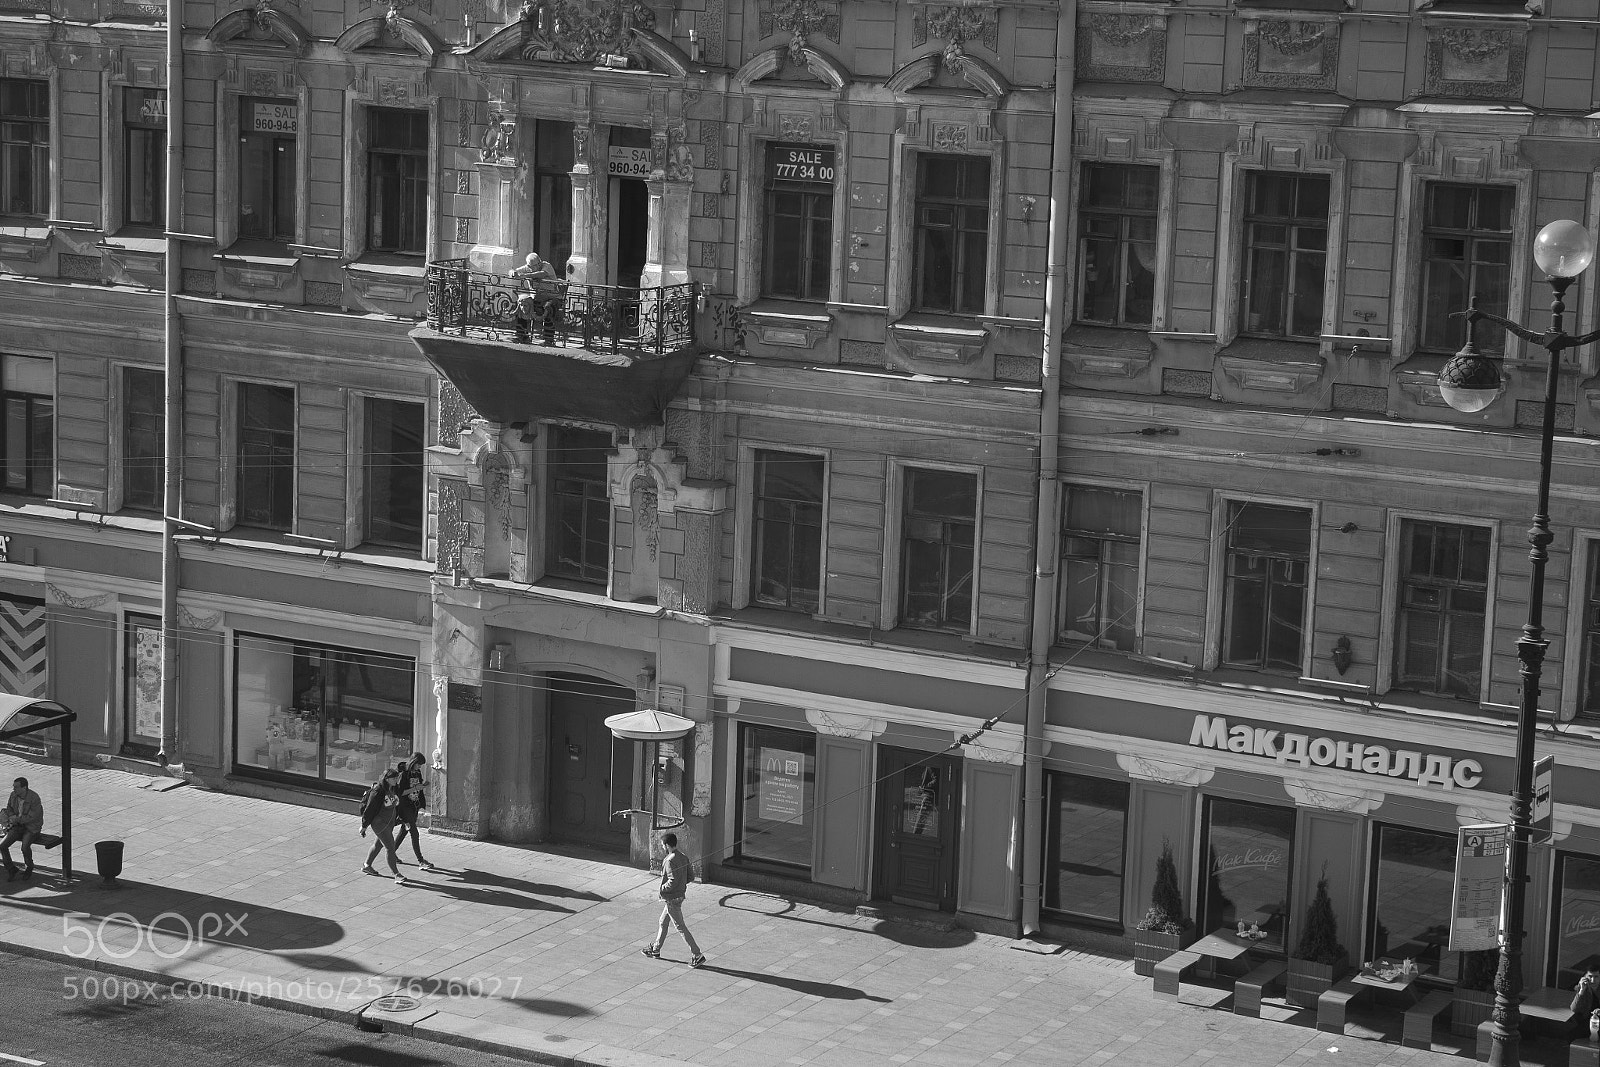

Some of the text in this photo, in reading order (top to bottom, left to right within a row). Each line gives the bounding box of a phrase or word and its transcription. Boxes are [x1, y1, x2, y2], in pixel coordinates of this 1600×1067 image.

[789, 151, 822, 164] SALE
[776, 163, 834, 180] 777 34 00
[1189, 714, 1483, 791] Макдоналдс
